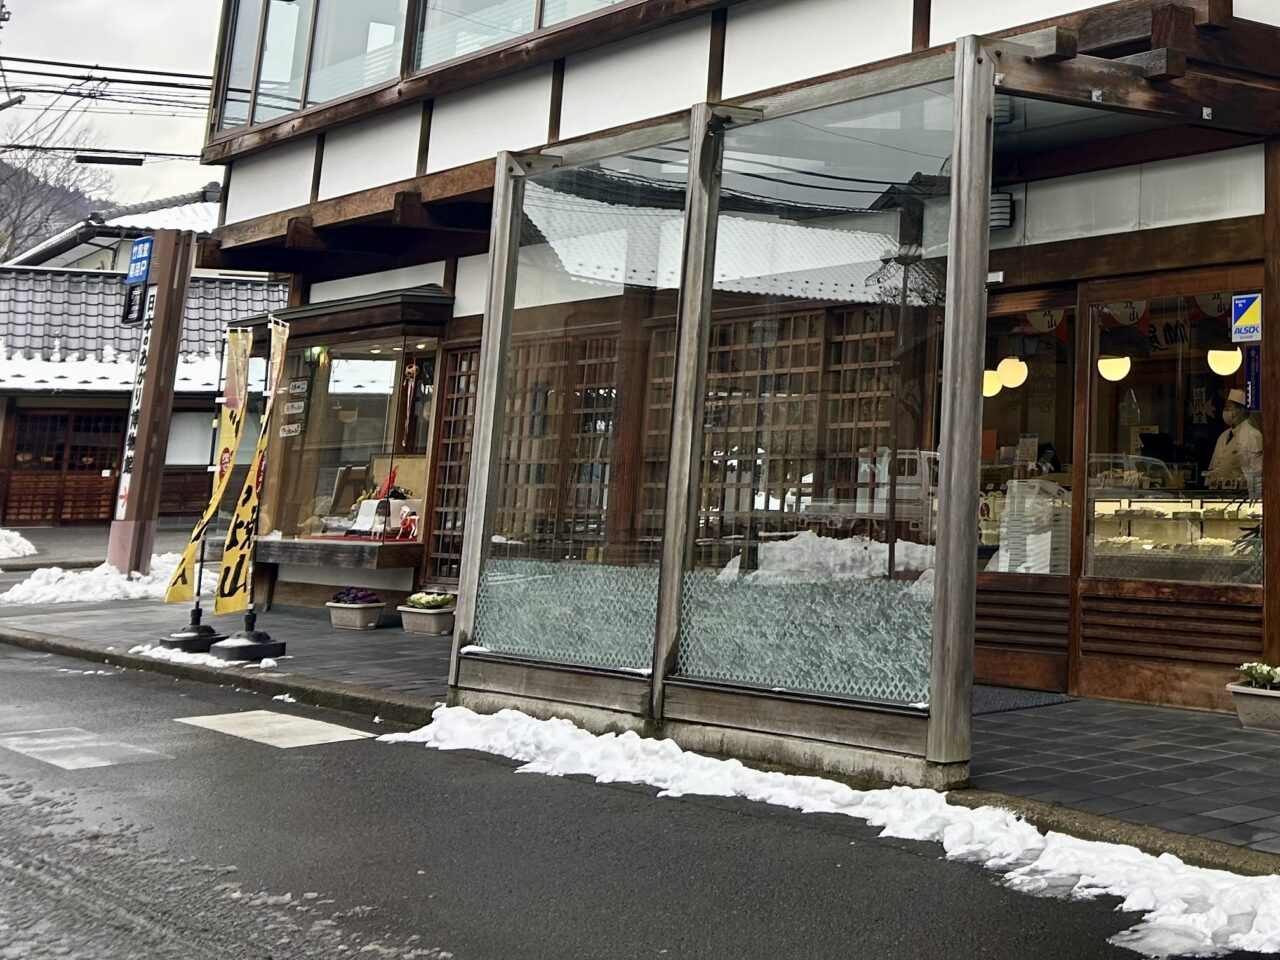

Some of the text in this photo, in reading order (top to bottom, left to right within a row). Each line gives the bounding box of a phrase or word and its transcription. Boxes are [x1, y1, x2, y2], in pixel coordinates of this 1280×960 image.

[1234, 325, 1260, 334] ALSOK
[122, 294, 156, 474] 日本のあかり博物館
